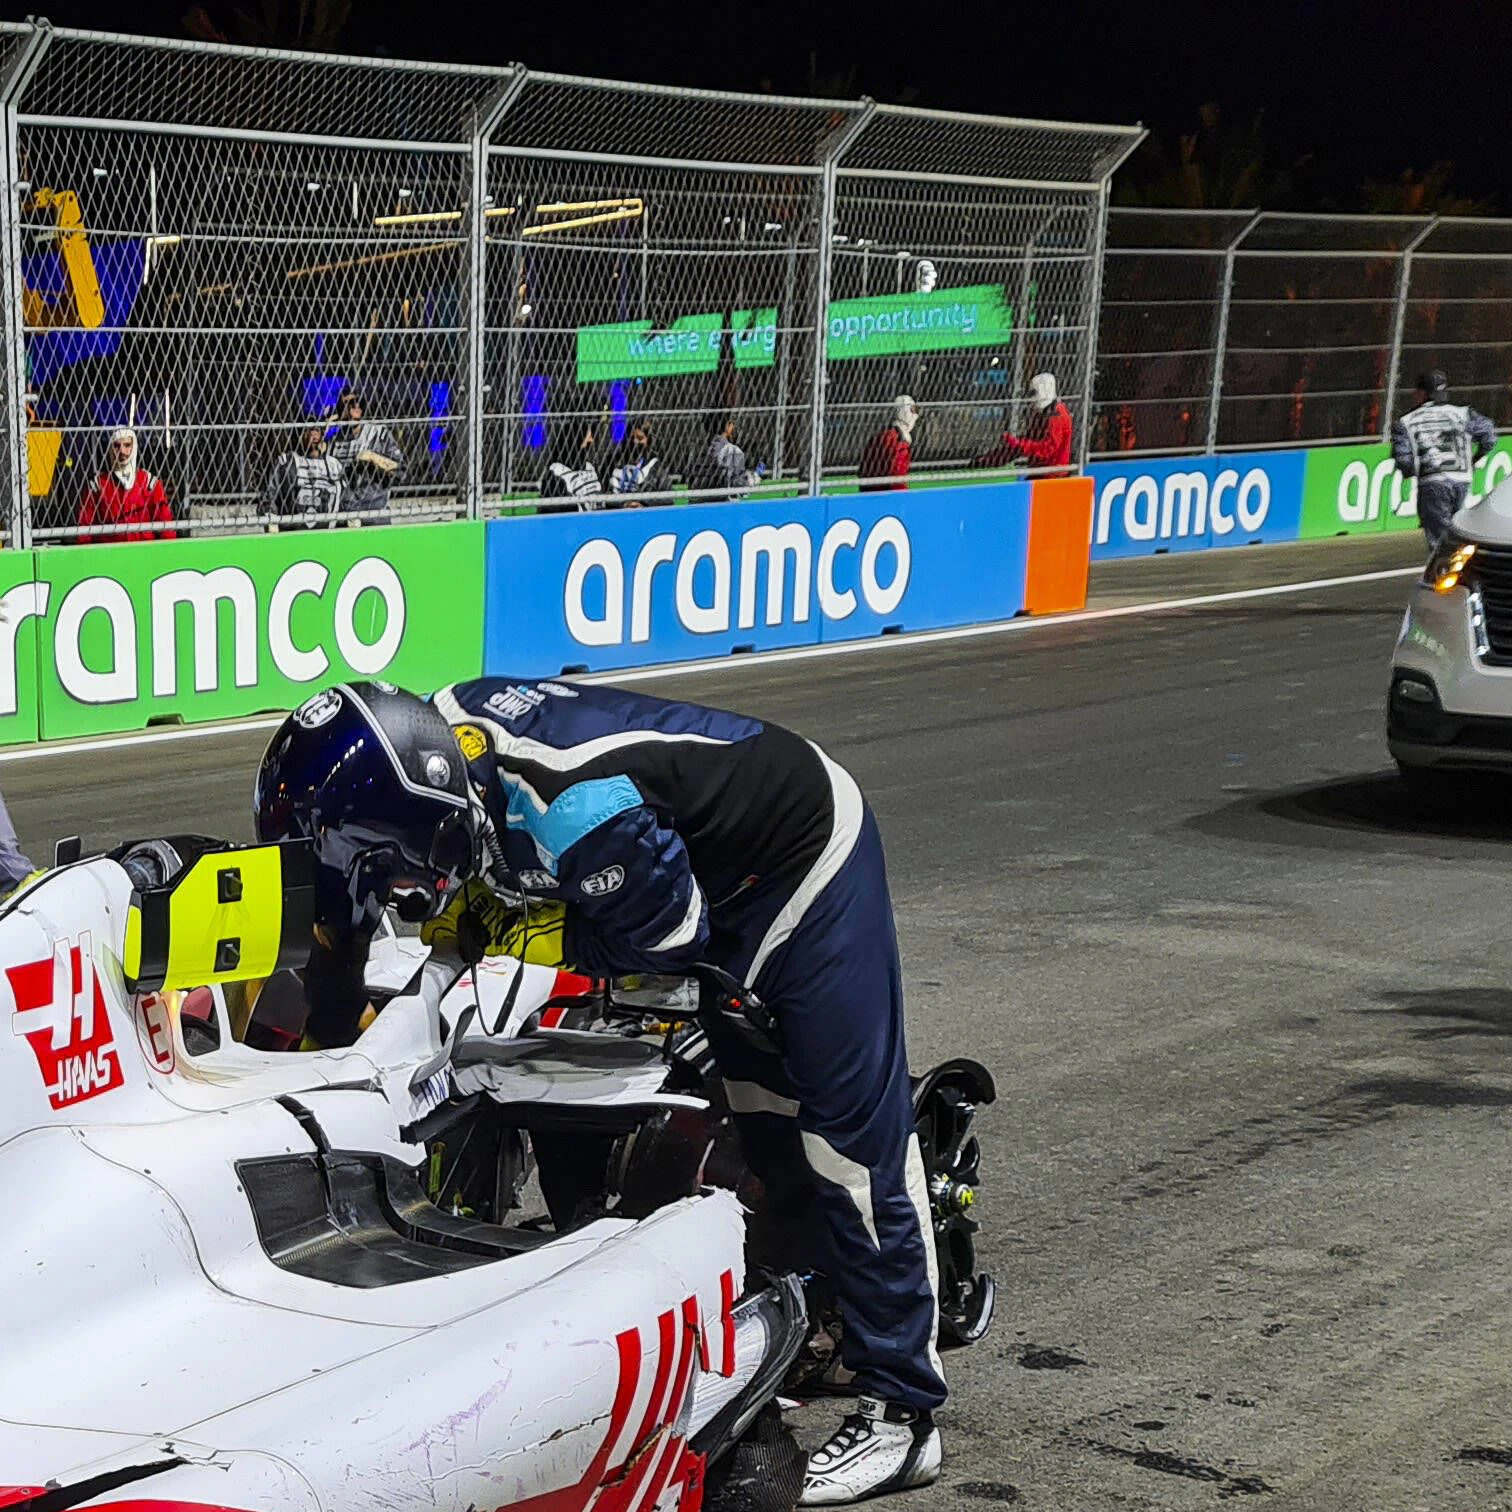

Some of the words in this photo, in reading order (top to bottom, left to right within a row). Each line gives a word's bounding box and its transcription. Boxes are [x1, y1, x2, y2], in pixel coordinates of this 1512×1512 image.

[1090, 467, 1271, 545] ramco
[563, 515, 912, 647] aramco
[582, 868, 622, 894] FIA
[141, 996, 170, 1064] E
[48, 1043, 117, 1102] HAAS
